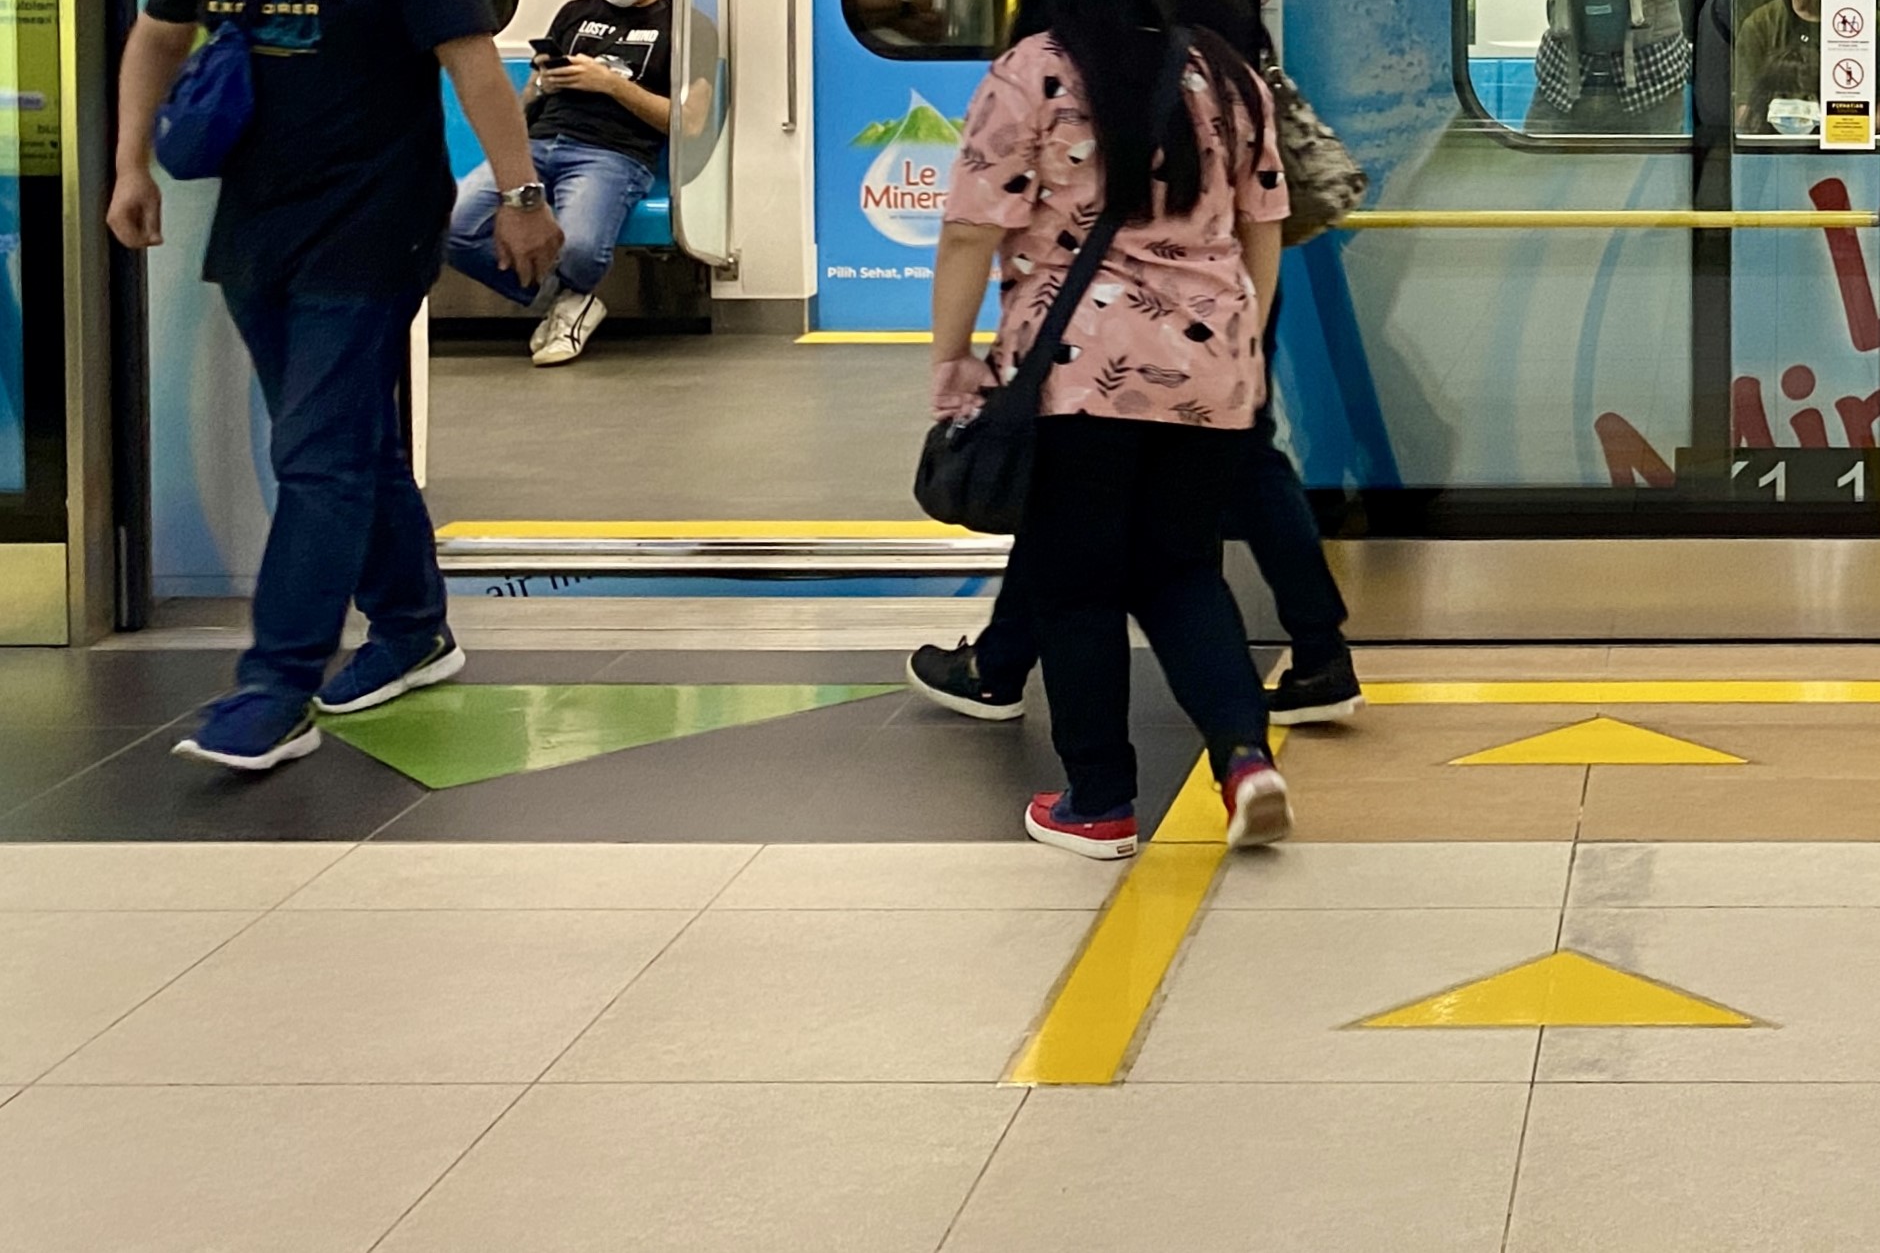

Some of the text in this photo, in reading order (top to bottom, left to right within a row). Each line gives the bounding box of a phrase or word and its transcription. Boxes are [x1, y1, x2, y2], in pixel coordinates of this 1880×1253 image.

[206, 0, 320, 16] EXPORER
[579, 21, 609, 36] LOST
[626, 29, 659, 43] MIND
[905, 160, 936, 187] Le
[827, 266, 935, 280] Pilih Sehat, Pilih
